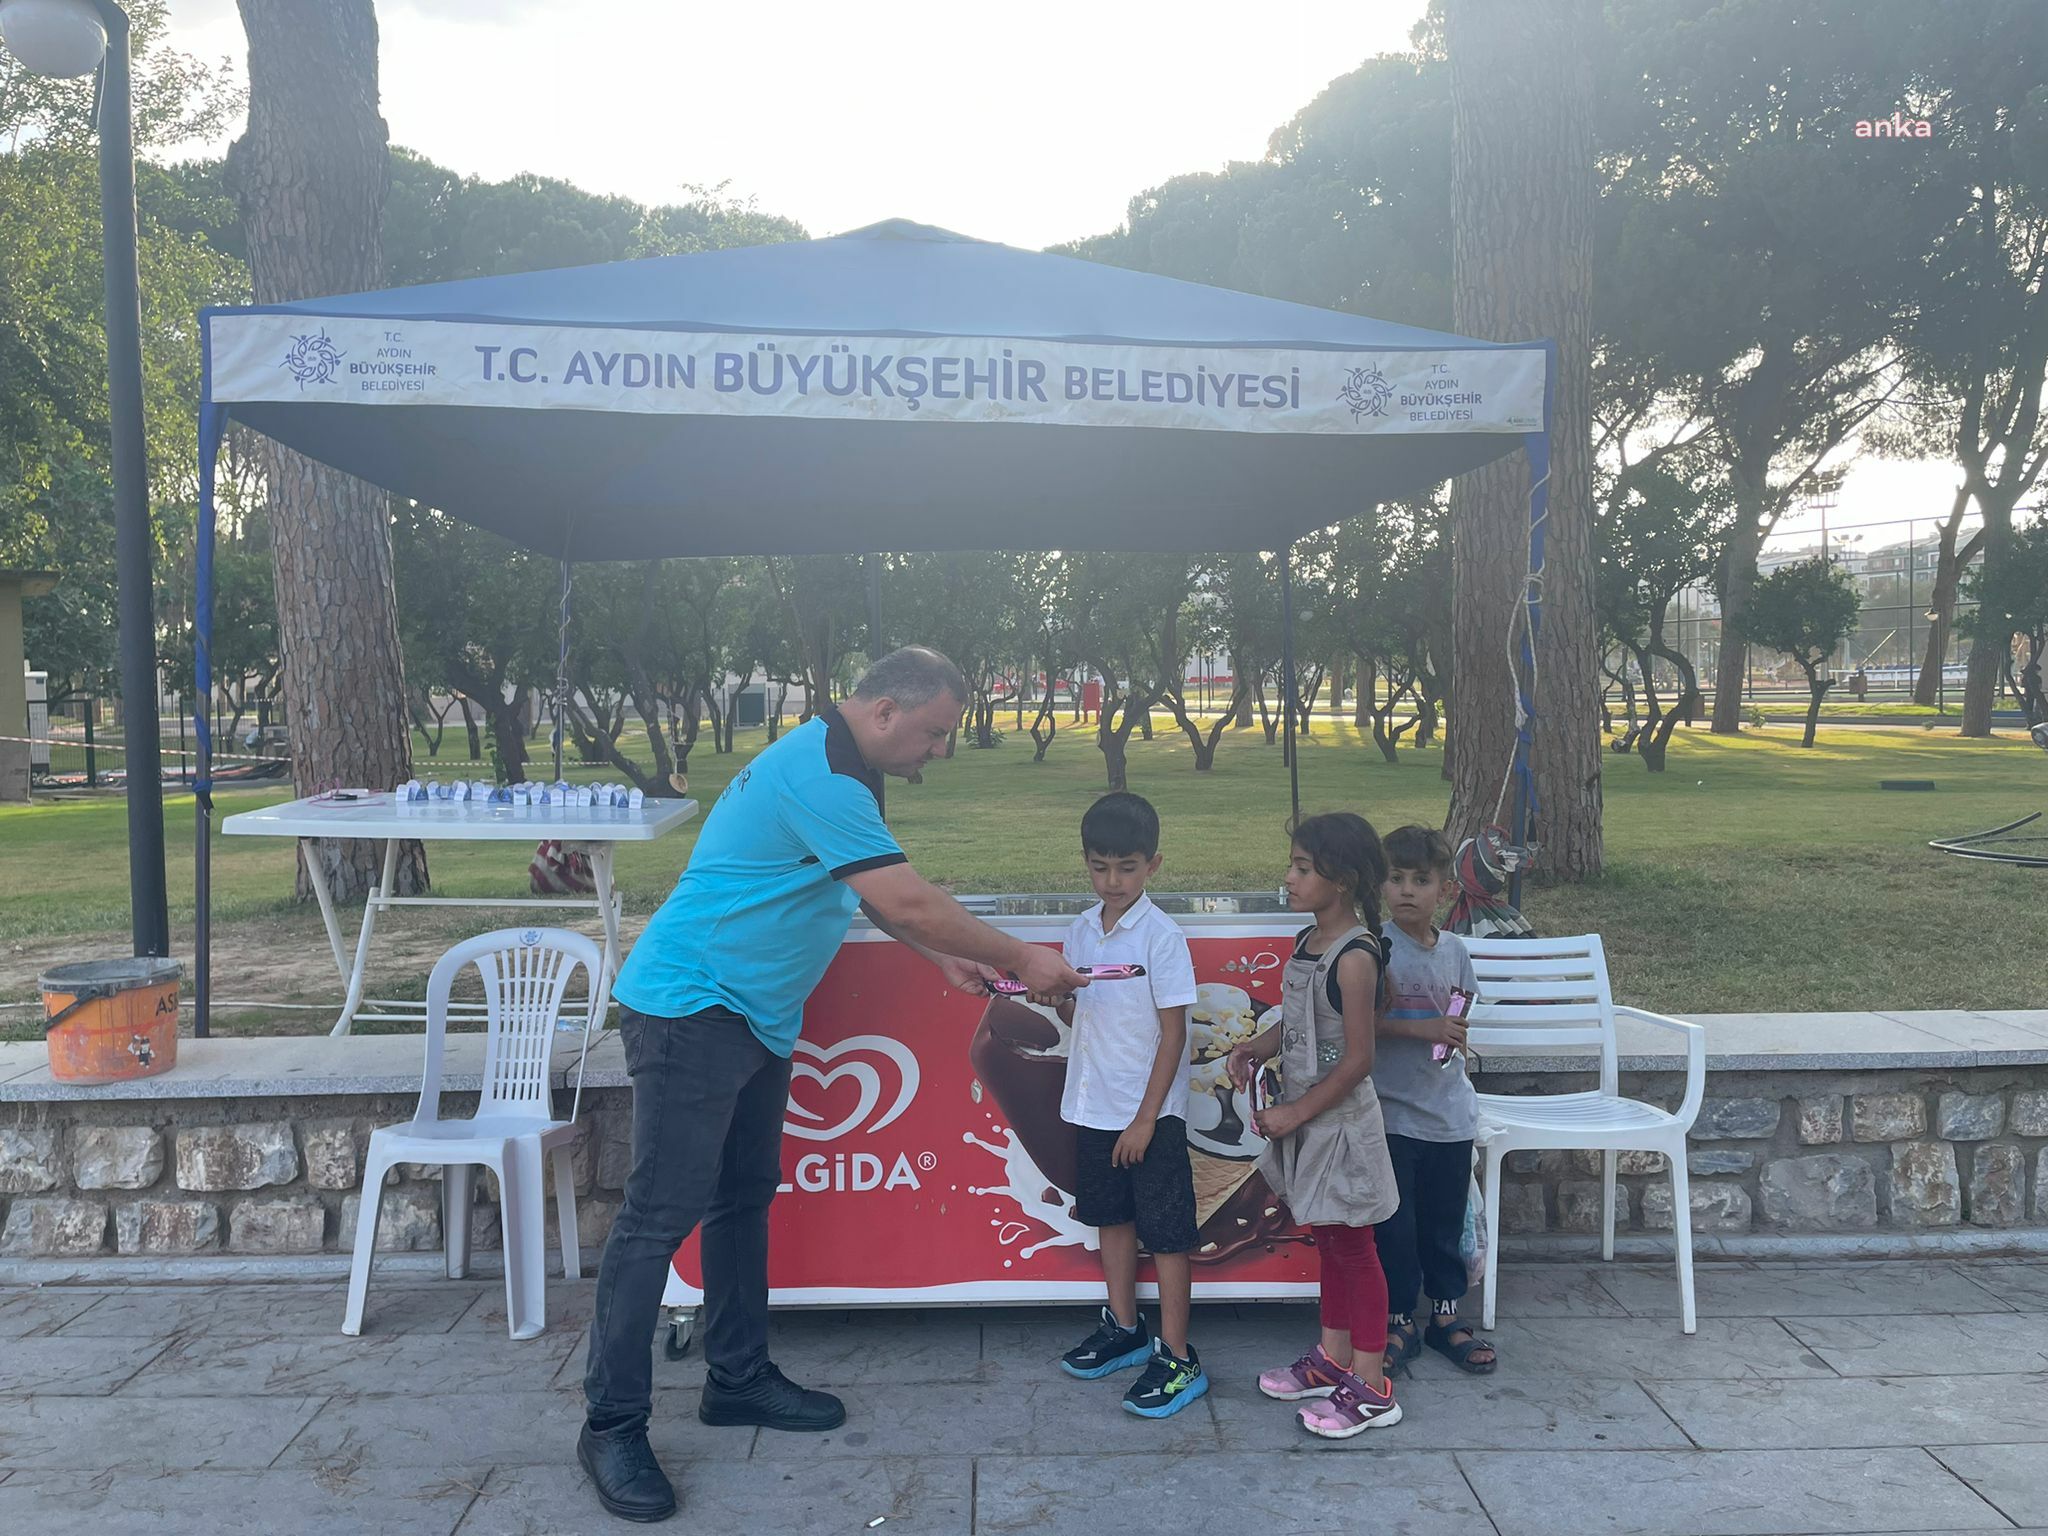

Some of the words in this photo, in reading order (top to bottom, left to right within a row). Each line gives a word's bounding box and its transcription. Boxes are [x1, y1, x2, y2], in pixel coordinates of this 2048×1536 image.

[384, 331, 403, 343] T.C.
[376, 347, 412, 359] AYDIN
[350, 361, 437, 377] BÜYÜKŞEHİR
[474, 345, 548, 384] T.C.
[562, 350, 696, 390] AYDIN
[713, 342, 1049, 411] BÜYÜKŞEHİR
[1064, 364, 1300, 409] BELEDİYESİ
[361, 379, 425, 392] BELEDİYESİ
[1424, 378, 1459, 390] AYDIN
[1400, 391, 1482, 407] BÜYÜKŞEHİR
[1409, 409, 1473, 422] BELEDİYESİ
